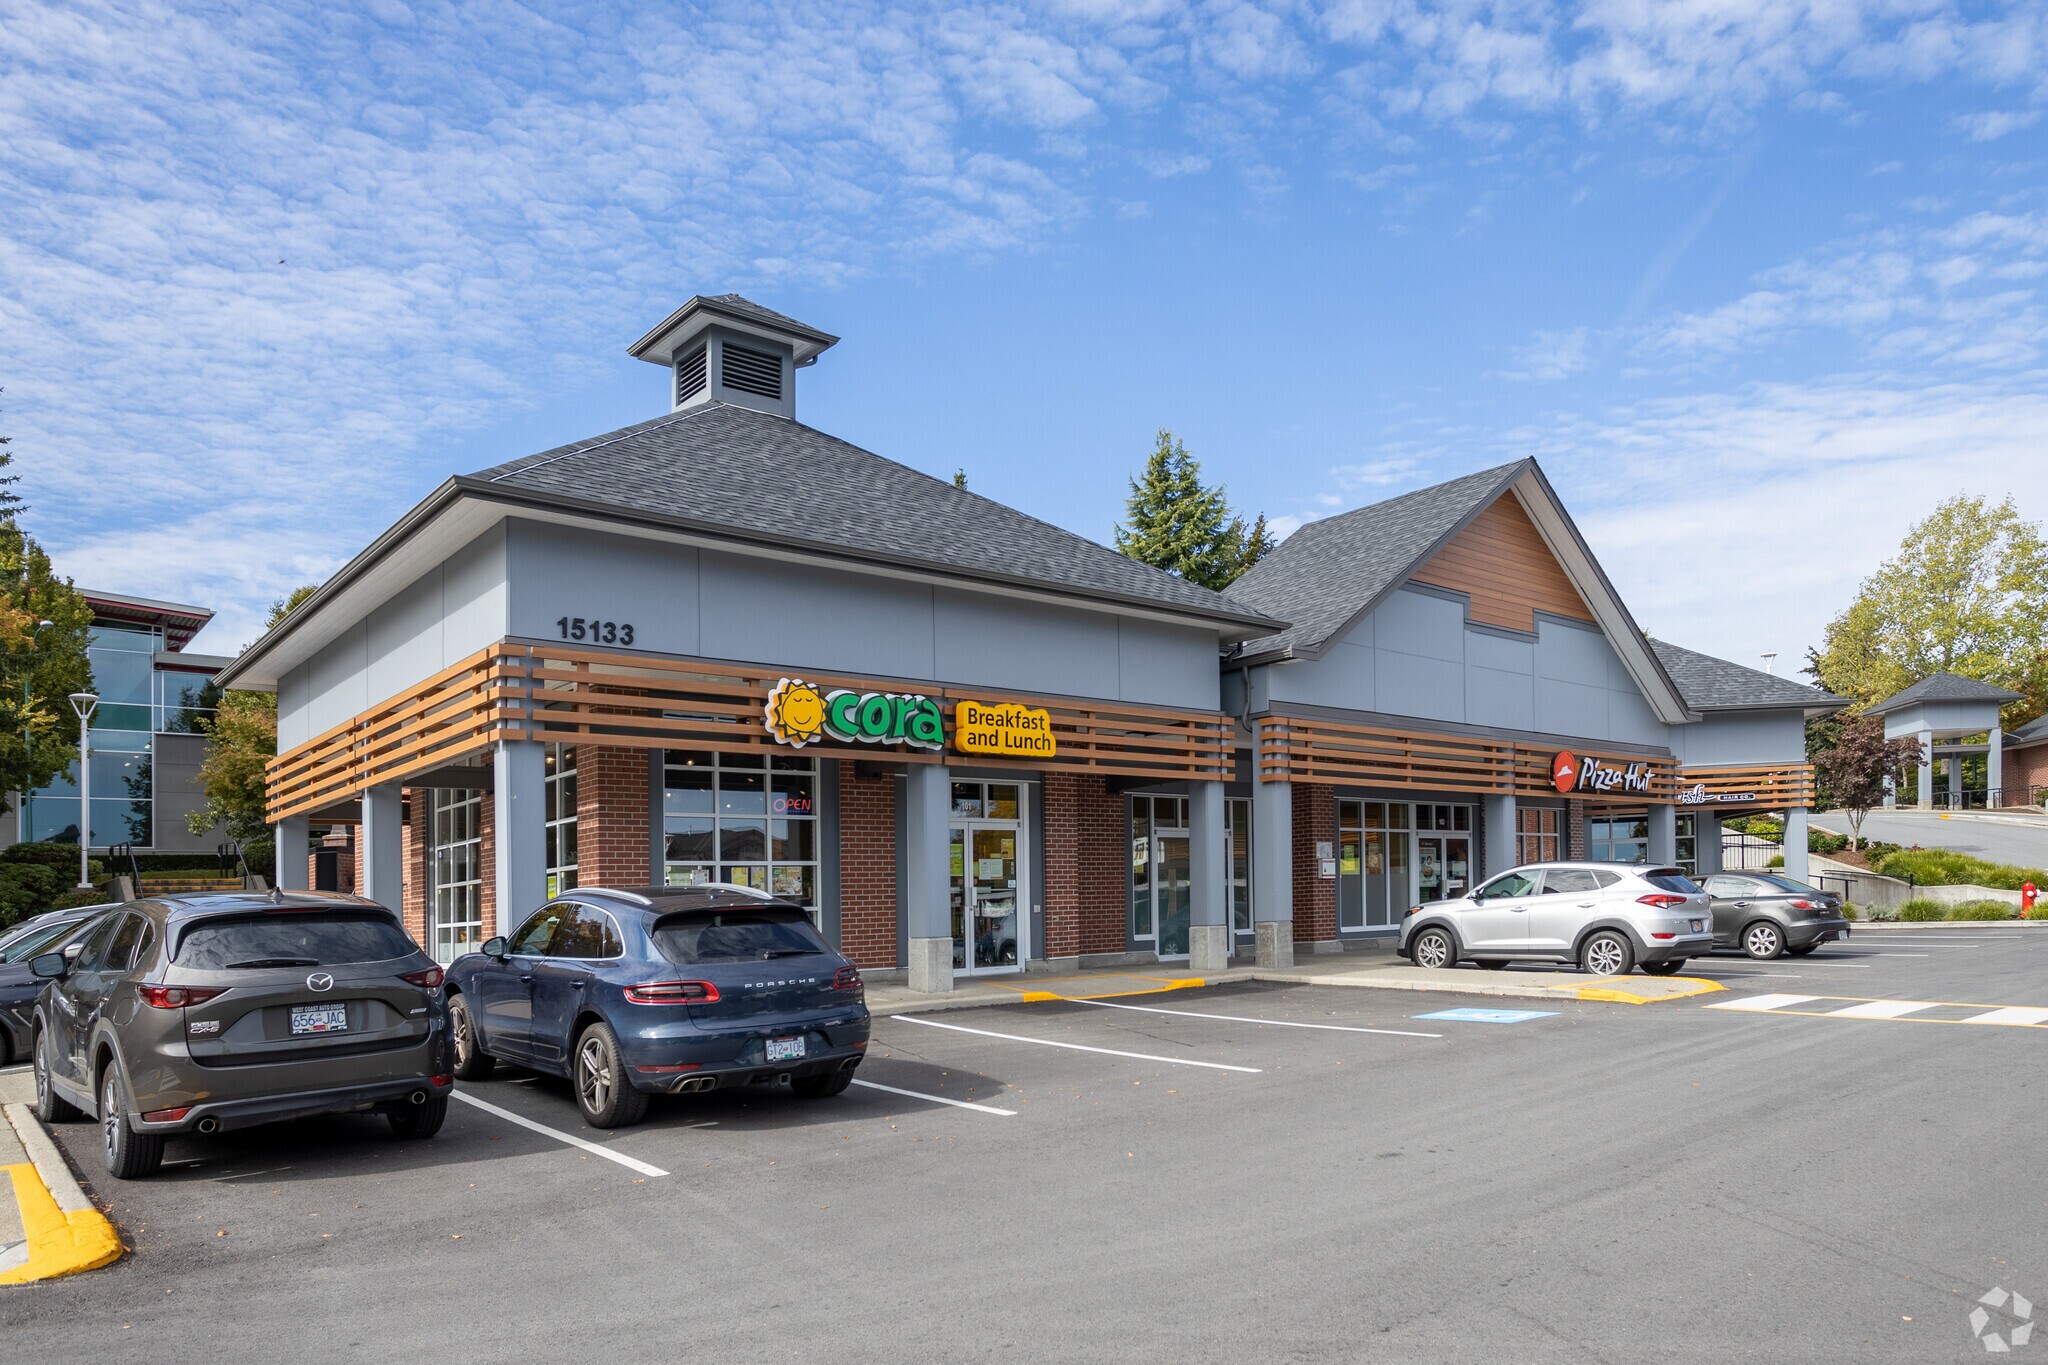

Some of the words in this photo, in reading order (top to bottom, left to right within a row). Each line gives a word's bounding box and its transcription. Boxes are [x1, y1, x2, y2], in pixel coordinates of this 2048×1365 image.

[557, 616, 634, 645] 15133
[826, 691, 945, 746] cora
[968, 708, 1045, 731] Breakfast
[967, 729, 998, 747] and
[1005, 731, 1051, 750] Lunch
[1578, 757, 1623, 790] Pizza
[1624, 763, 1656, 791] Hut
[773, 798, 811, 812] OPEN
[745, 977, 815, 989] PORSCHE
[293, 1014, 316, 1028] 656
[323, 1011, 345, 1025] JAC
[767, 1043, 783, 1056] GT2
